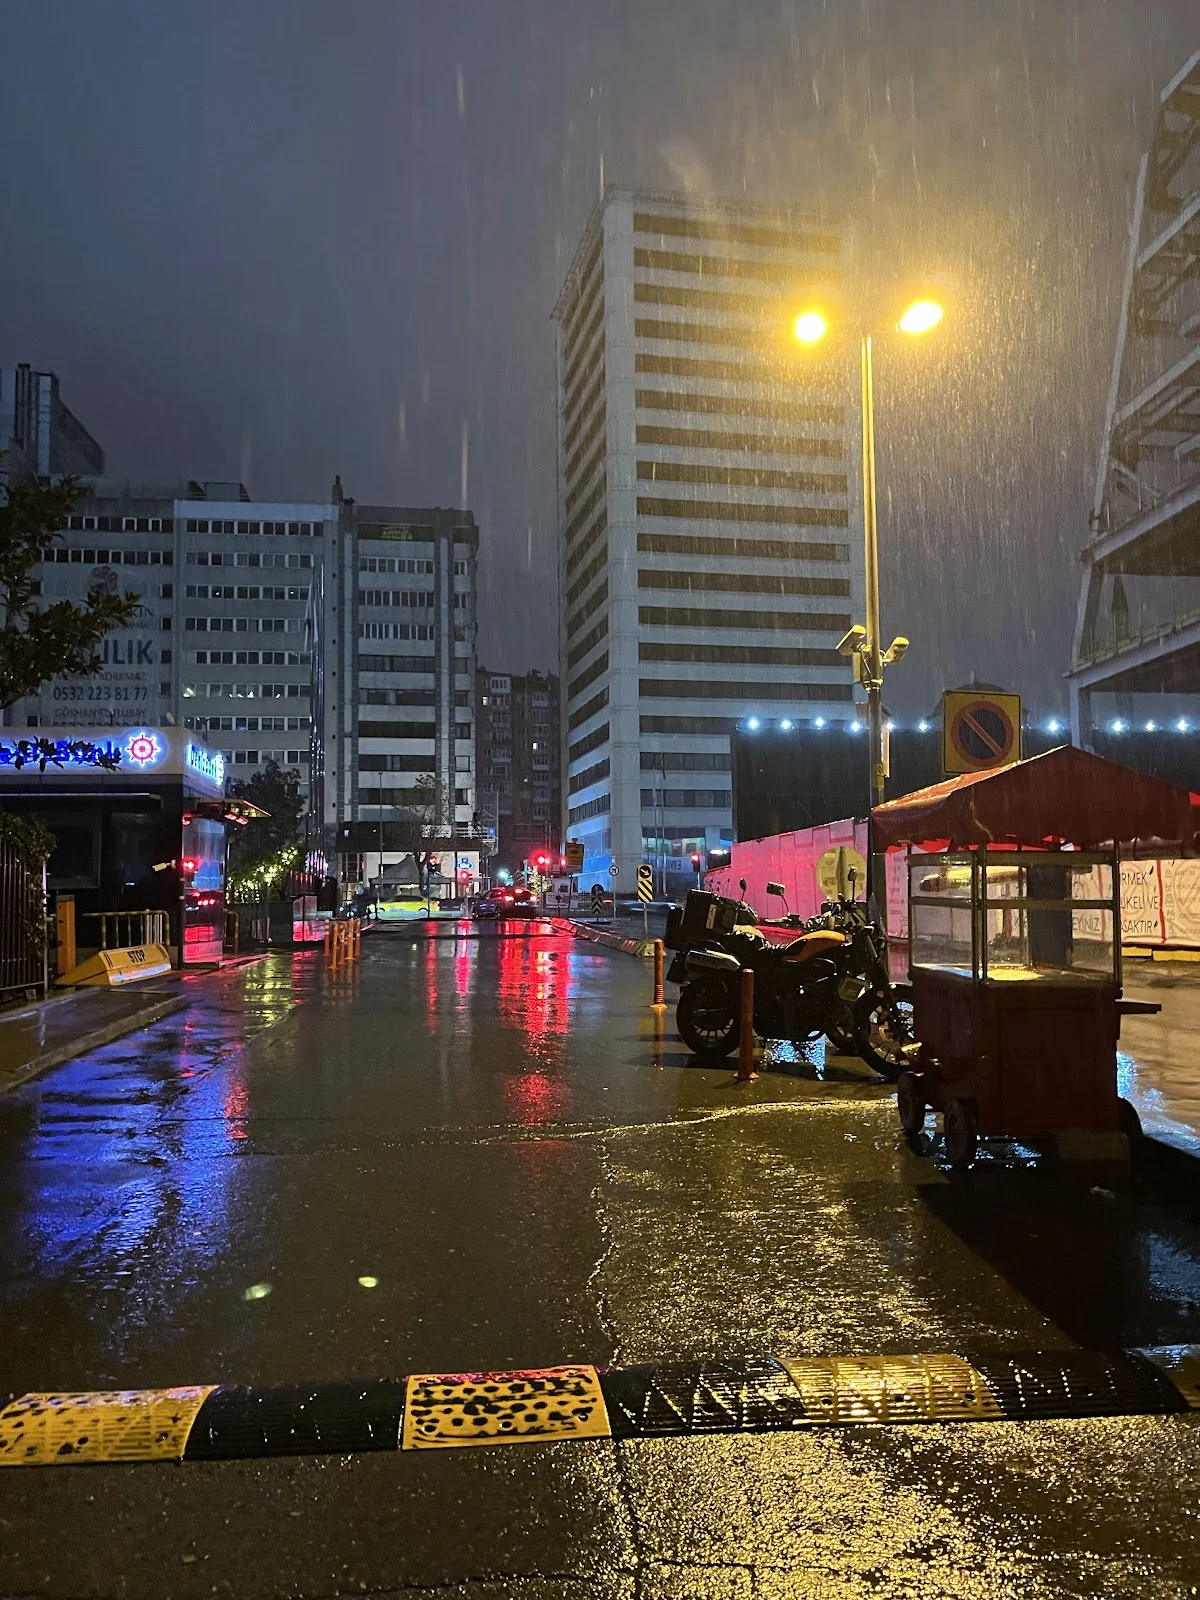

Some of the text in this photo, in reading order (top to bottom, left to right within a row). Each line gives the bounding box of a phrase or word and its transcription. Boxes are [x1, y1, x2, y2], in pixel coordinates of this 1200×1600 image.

[53, 686, 148, 701] 0532 223 81 77
[127, 949, 146, 964] STOP
